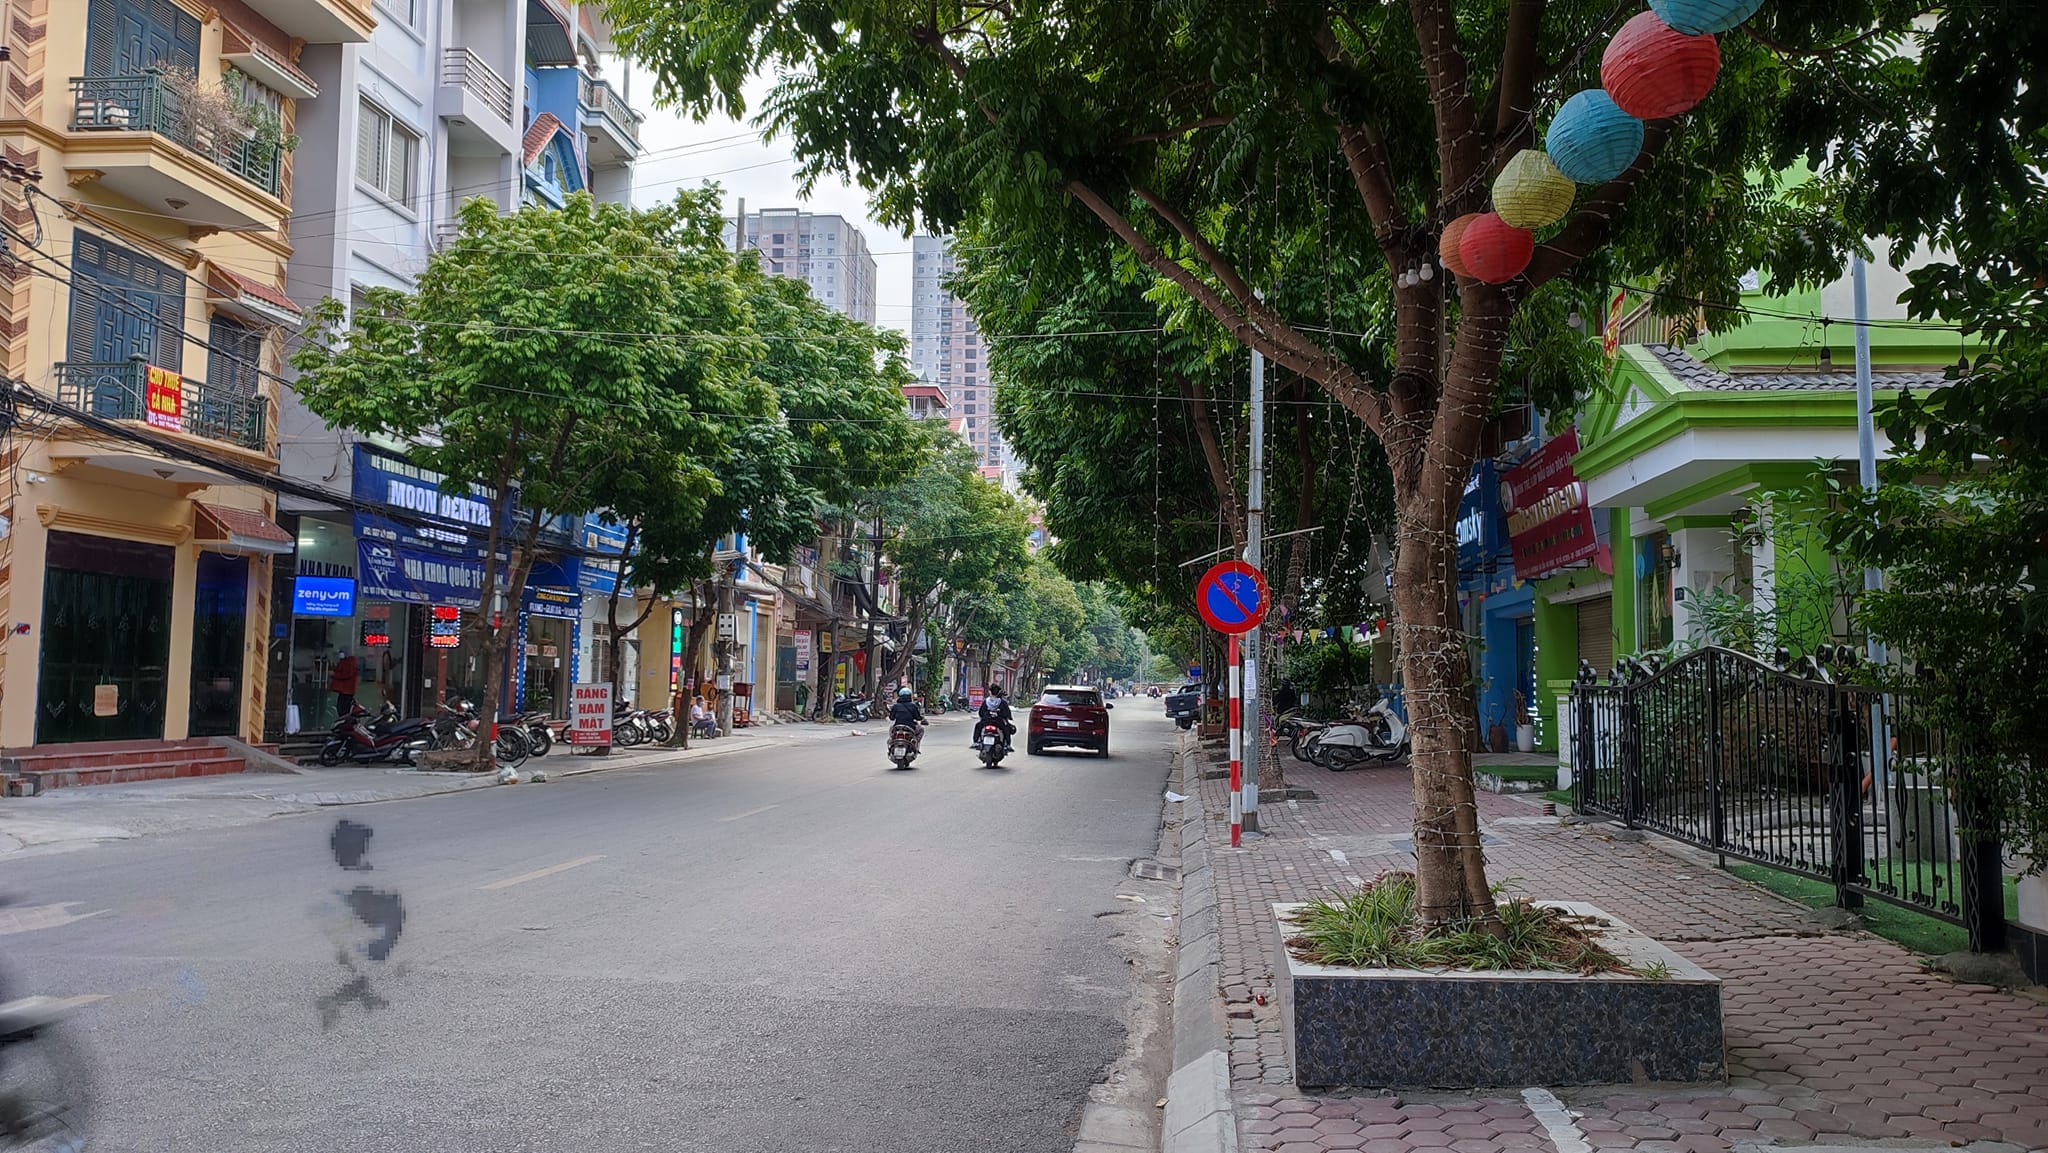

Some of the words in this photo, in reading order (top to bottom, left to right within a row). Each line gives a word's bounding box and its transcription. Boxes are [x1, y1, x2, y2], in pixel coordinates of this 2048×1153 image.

[388, 480, 437, 514] MOON
[404, 558, 422, 580] NHA
[424, 562, 447, 584] KHOA
[448, 562, 470, 588] QUỐC
[298, 589, 350, 601] zenyum
